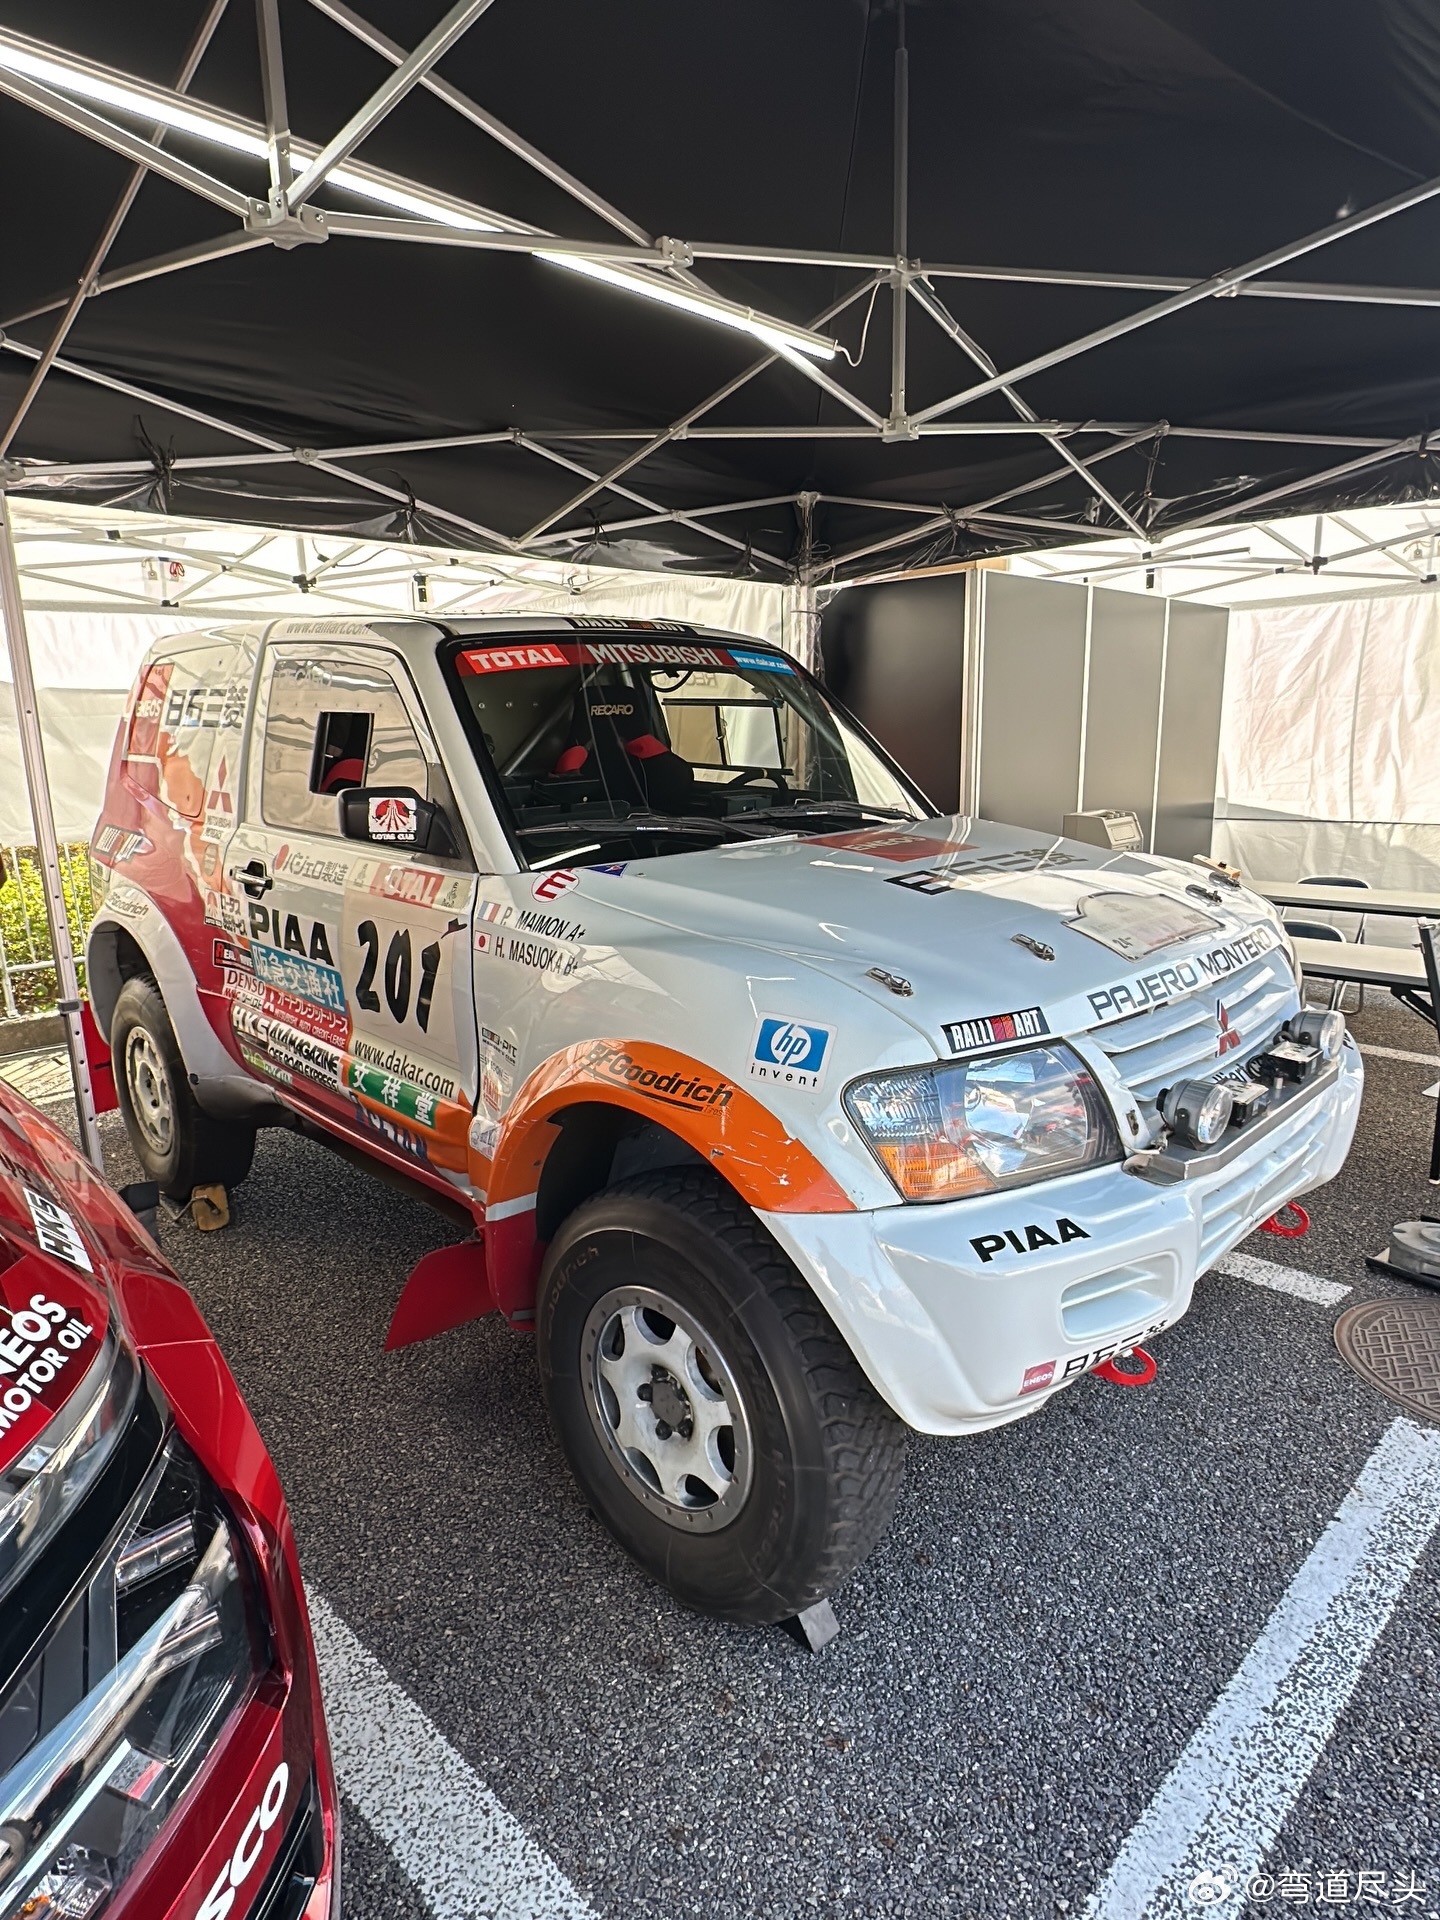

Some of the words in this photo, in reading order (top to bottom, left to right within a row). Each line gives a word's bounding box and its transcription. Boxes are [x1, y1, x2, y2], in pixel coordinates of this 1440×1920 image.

[469, 648, 564, 669] TOTAL
[586, 643, 723, 665] MITSUBISHI
[590, 704, 634, 716] RECARO
[378, 865, 437, 904] OTAL
[250, 903, 335, 967] PIAA
[500, 907, 513, 925] P.
[515, 910, 570, 939] MAIMON
[565, 924, 586, 941] A+
[355, 919, 441, 1034] 201
[494, 936, 505, 958] H.
[508, 939, 563, 974] MASUOKA
[563, 955, 579, 976] B+
[1086, 962, 1199, 1020] PAJERO
[1196, 927, 1273, 980] MONTERO
[227, 970, 265, 996] DENSO
[251, 944, 345, 1011] 阪急交通社
[232, 1005, 270, 1042] HKS
[299, 1019, 311, 1032] AUTO
[774, 1023, 808, 1066] hp
[304, 1065, 339, 1091] EXPRESS
[354, 1040, 454, 1098] www.dakar.com
[585, 1042, 734, 1107] BFGoodrich
[750, 1062, 818, 1087] invent
[353, 1062, 434, 1126] 文祥堂
[28, 1192, 76, 1261] HKS
[968, 1217, 1092, 1264] PIAA
[0, 1347, 69, 1439] MOTOR
[57, 1318, 93, 1350] OIL
[1023, 1371, 1053, 1387] ENEOS
